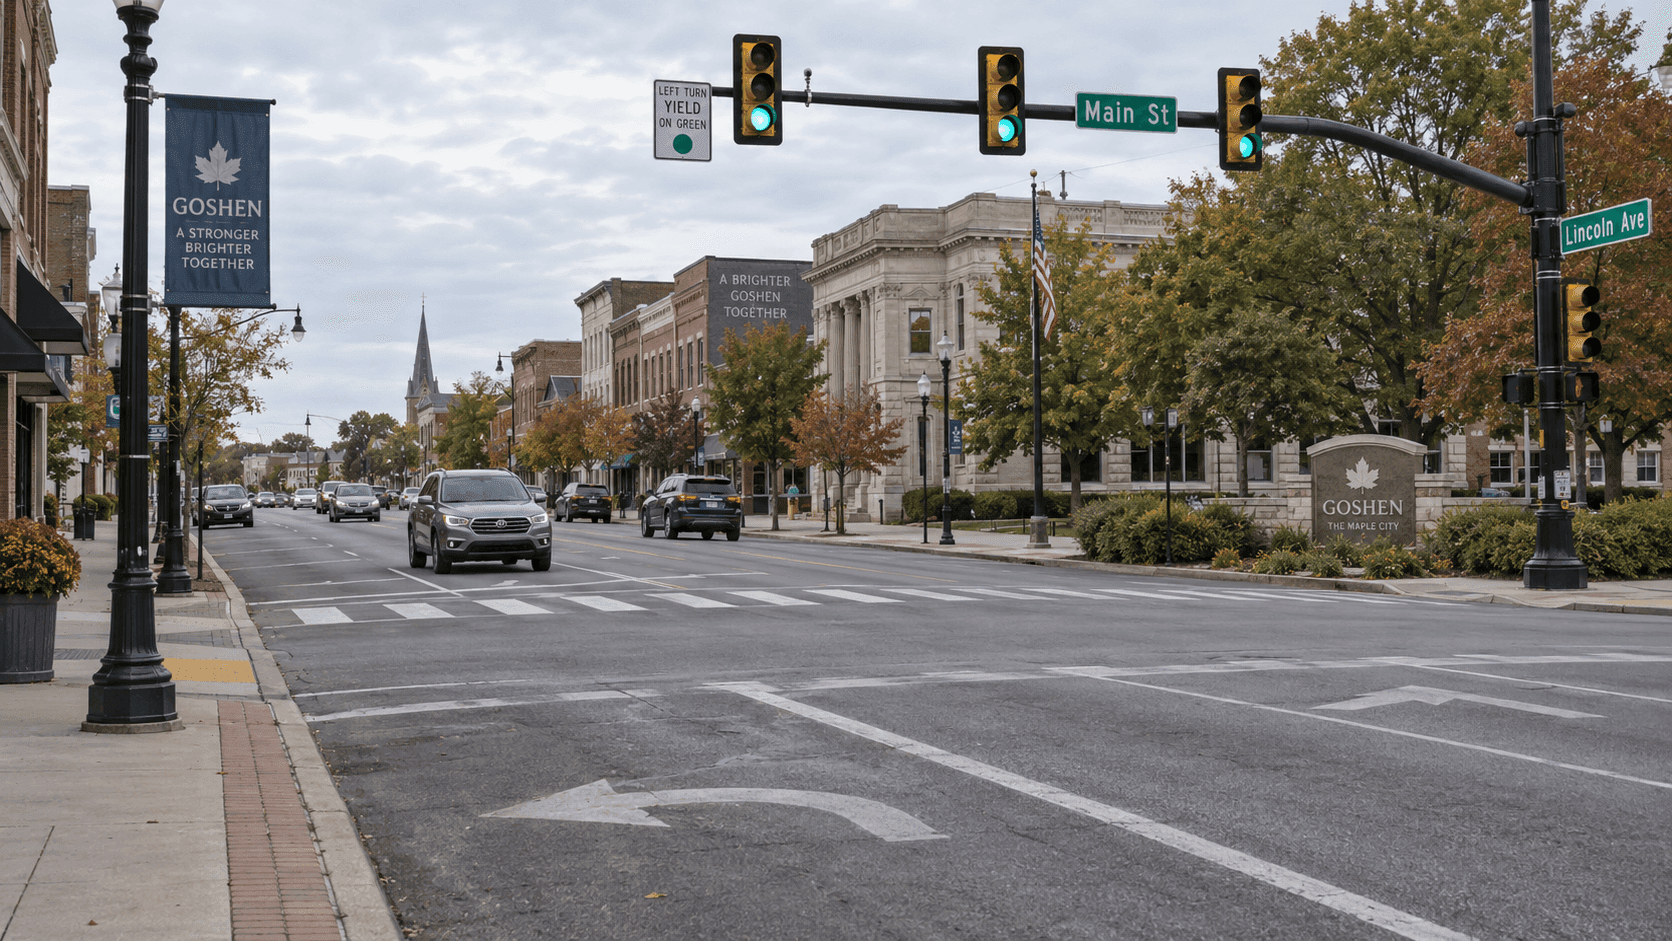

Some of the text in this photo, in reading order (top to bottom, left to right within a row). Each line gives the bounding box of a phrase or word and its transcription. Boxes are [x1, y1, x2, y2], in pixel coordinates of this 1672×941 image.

[659, 86, 707, 98] LEFT TURN
[664, 100, 701, 114] YIELD
[1085, 100, 1169, 125] Main St
[659, 117, 707, 130] ON GREEN
[172, 197, 262, 217] GOSHEN
[176, 227, 259, 240] A STRONGER
[1566, 211, 1645, 246] Lincoln Ave
[185, 241, 252, 254] BRIGHTER
[181, 257, 255, 270] TOGETHER
[719, 274, 791, 287] A BRIGHTER
[730, 290, 781, 302] GOSHEN
[723, 306, 787, 319] TOGETHER
[1322, 499, 1404, 516] GOSHEN
[1328, 521, 1399, 531] THE MAPLE CITY
